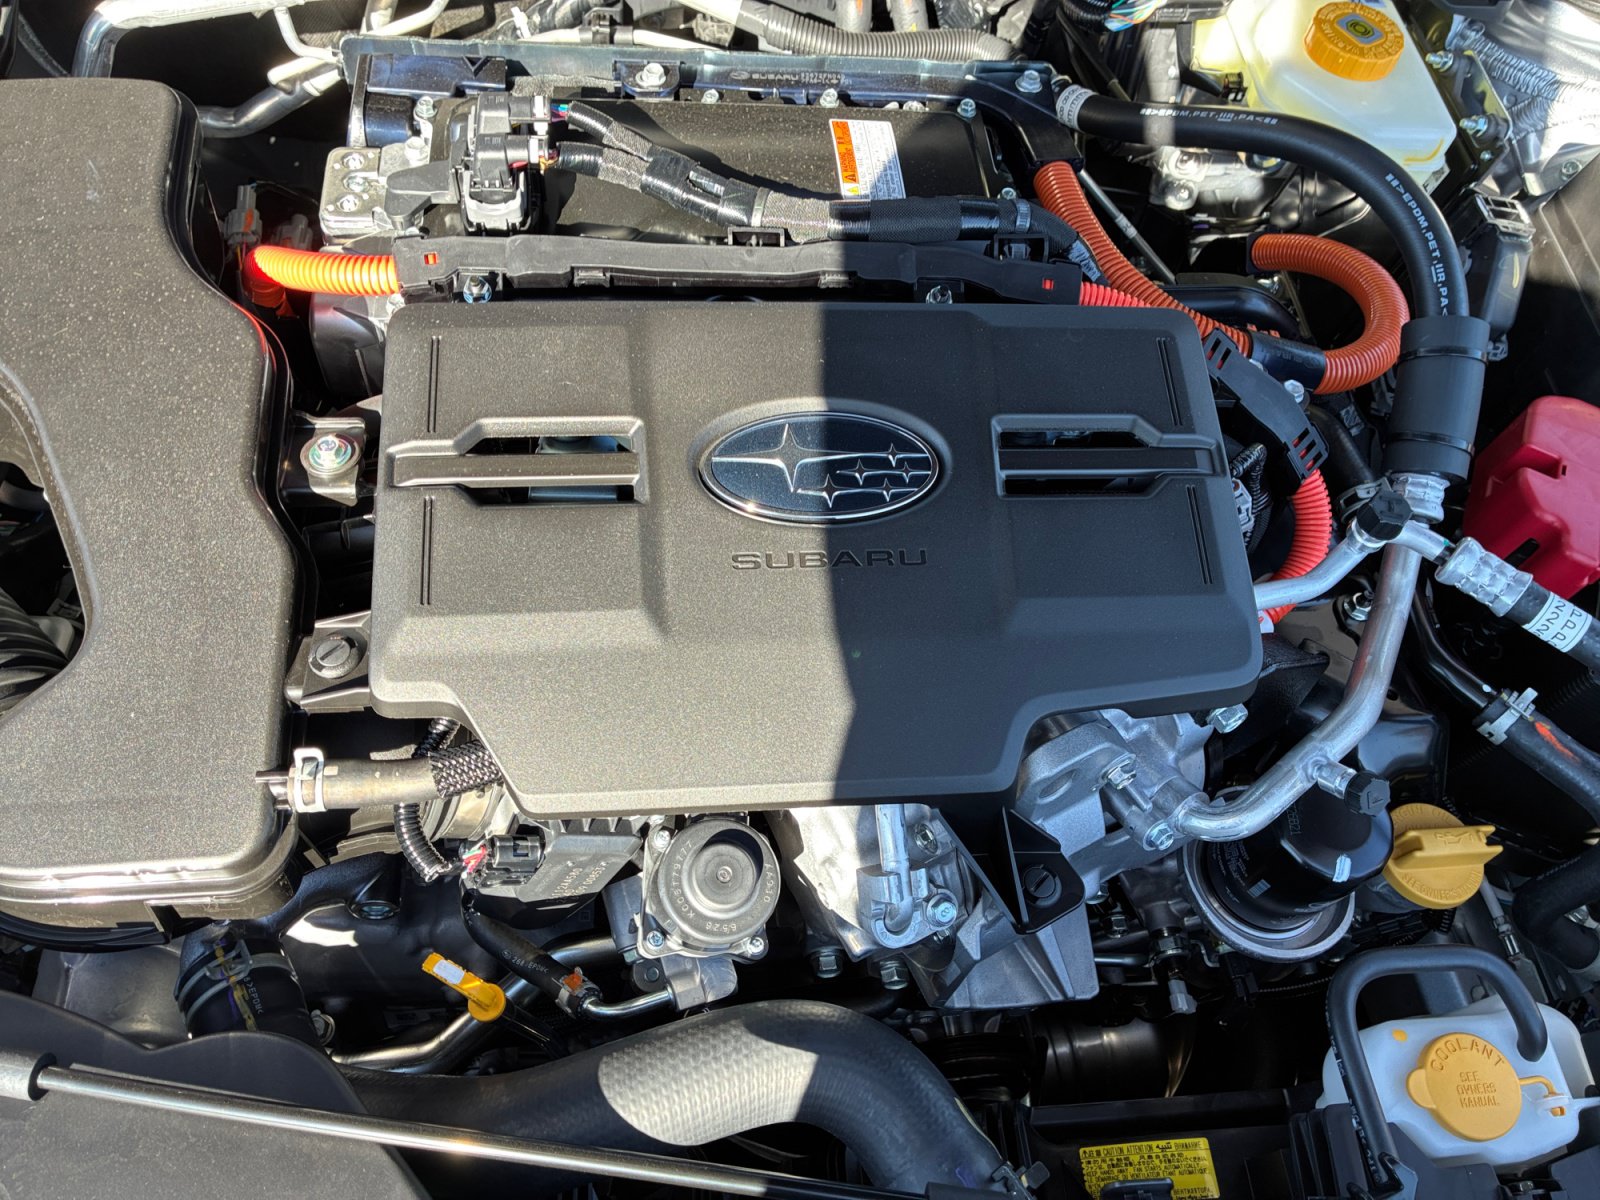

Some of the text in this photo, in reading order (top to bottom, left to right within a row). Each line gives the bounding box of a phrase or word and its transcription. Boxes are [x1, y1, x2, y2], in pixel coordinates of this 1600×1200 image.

[731, 549, 928, 570] SUBARU
[1430, 1038, 1505, 1071] COOLANT
[1459, 1071, 1480, 1083] SEE
[1456, 1082, 1497, 1095] OWNERS
[1459, 1095, 1500, 1109] MANUAL
